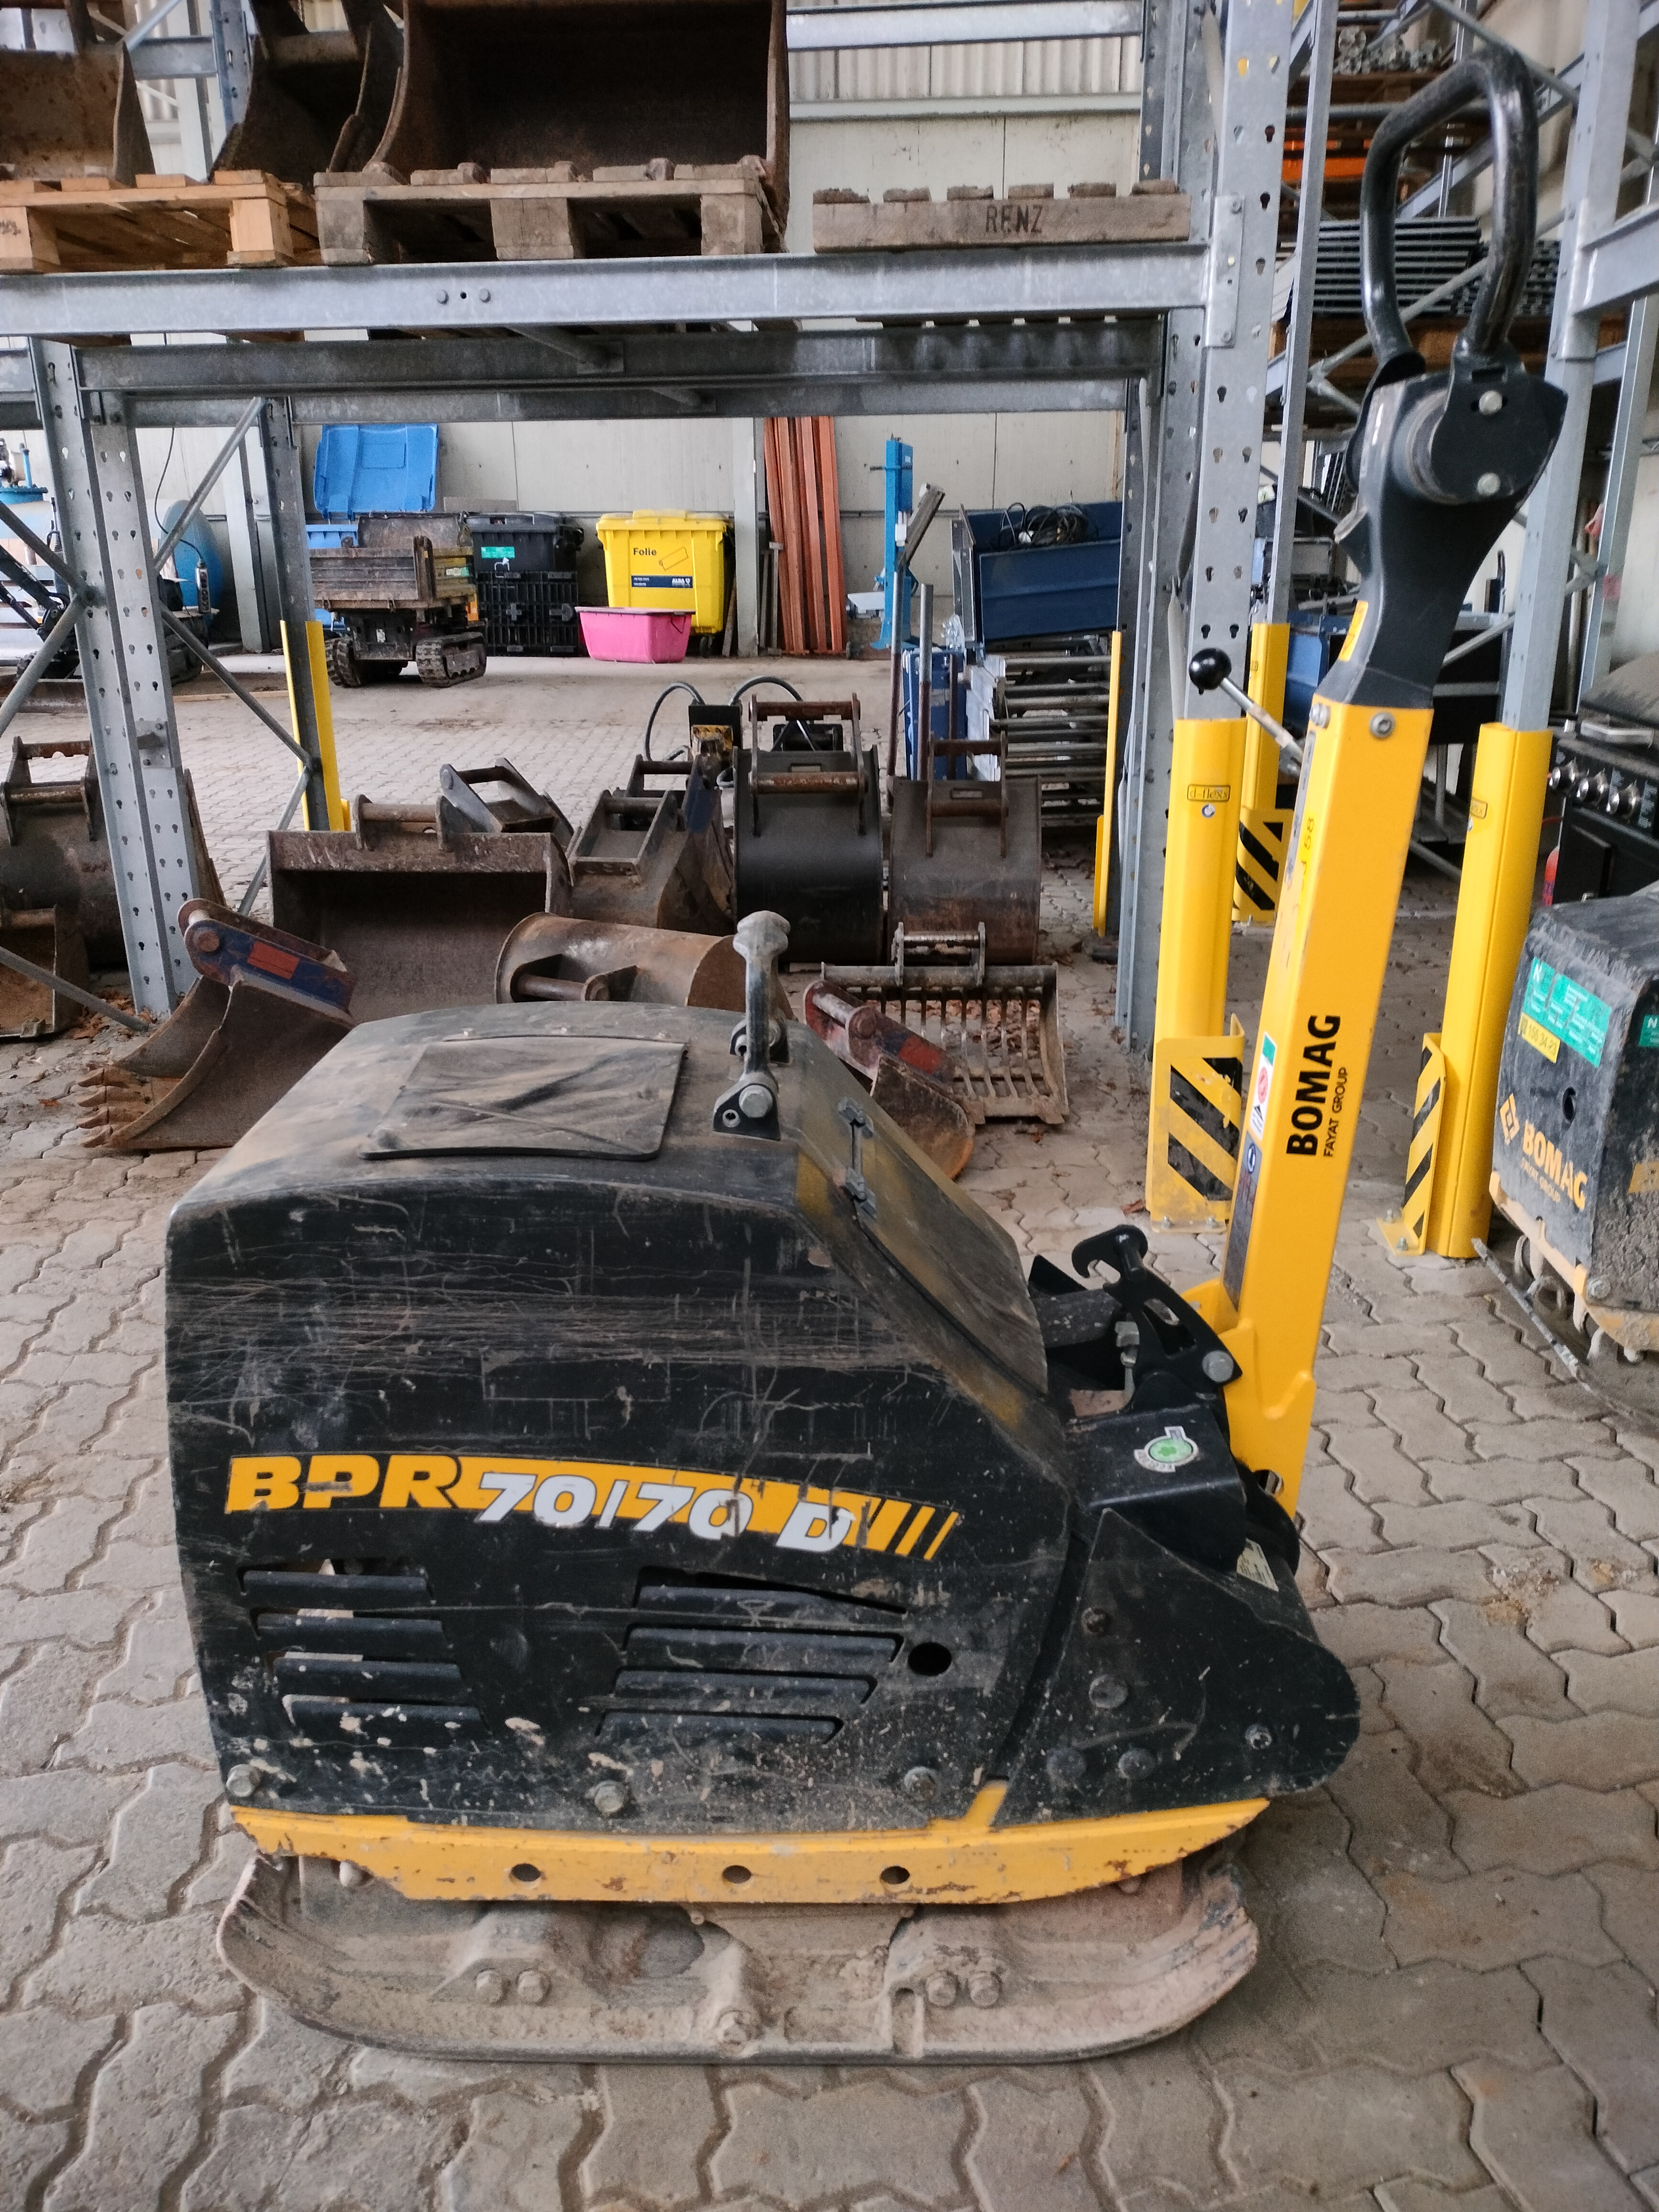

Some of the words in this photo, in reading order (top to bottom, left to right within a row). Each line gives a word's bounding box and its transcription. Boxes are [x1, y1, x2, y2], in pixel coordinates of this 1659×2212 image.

[985, 204, 1043, 233] RENZ
[633, 547, 657, 556] Folie
[1285, 1014, 1341, 1156] BOMAG
[1323, 1117, 1339, 1158] FAYAT
[1332, 1067, 1348, 1113] GROUP
[1523, 1119, 1587, 1211] BOMAG
[224, 1453, 458, 1514] BPR
[775, 1500, 856, 1553] D
